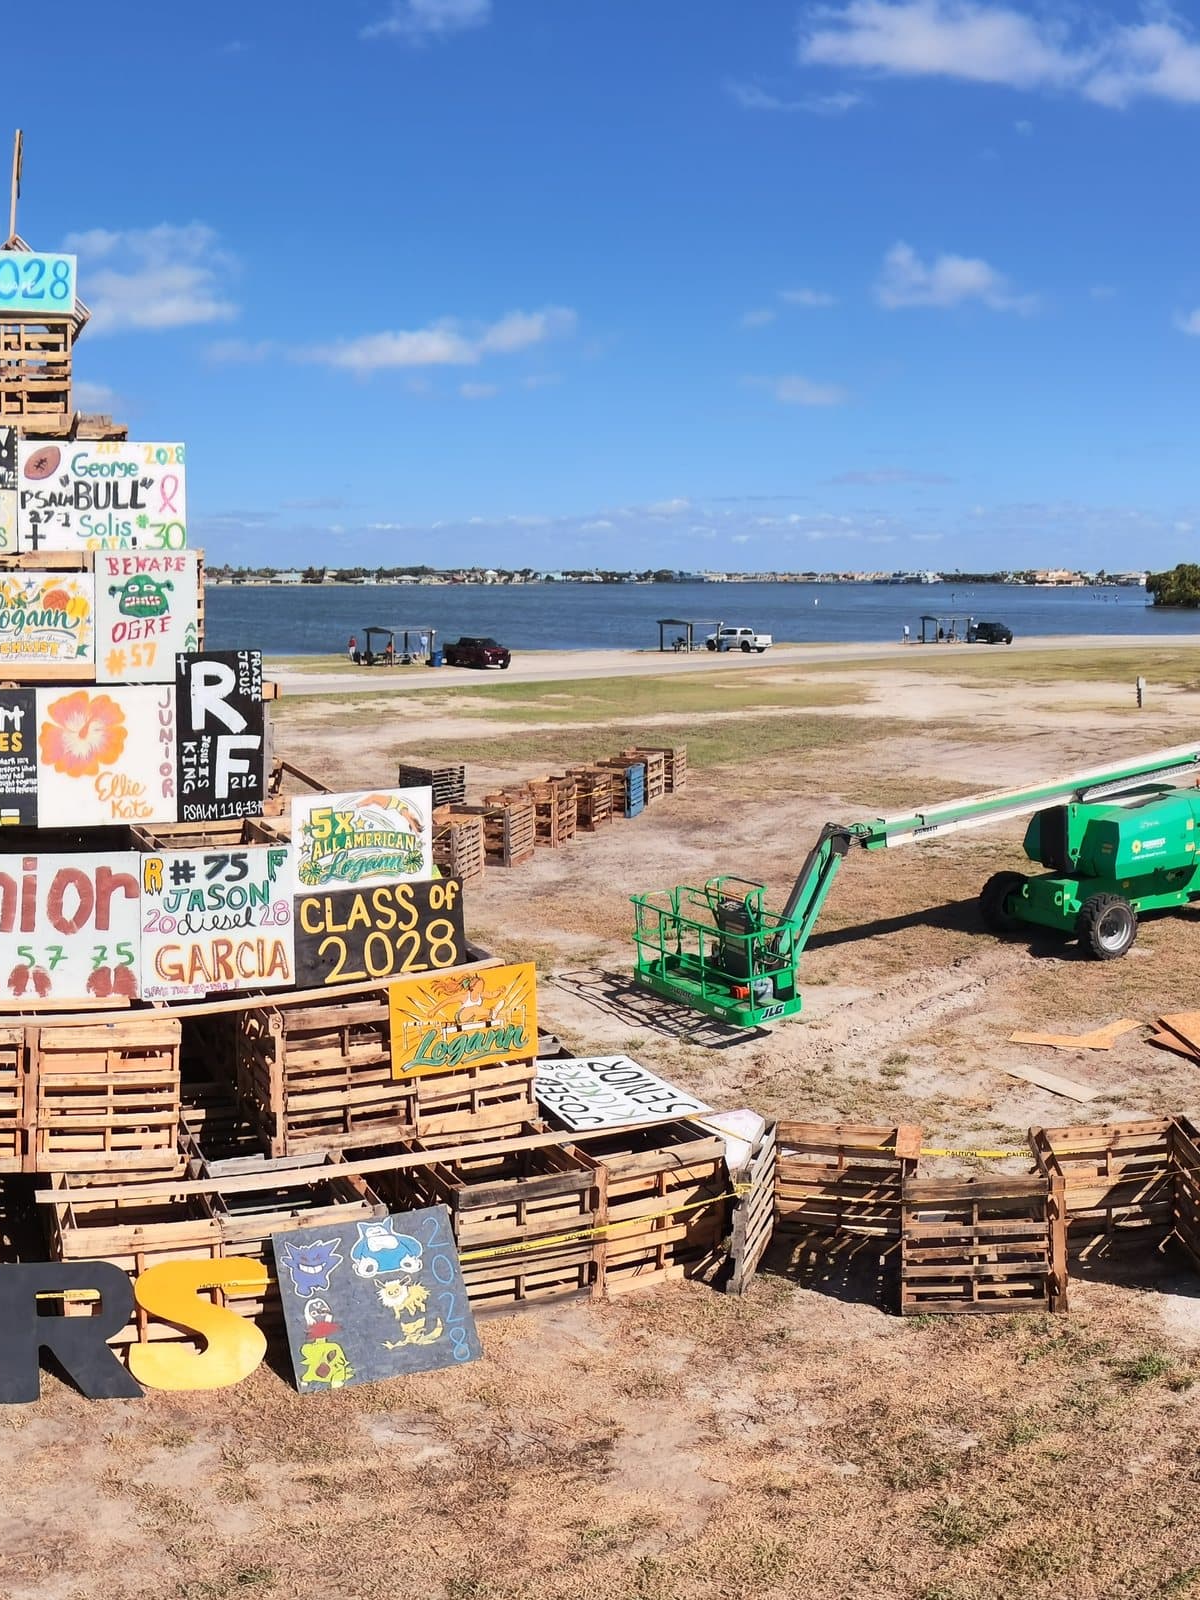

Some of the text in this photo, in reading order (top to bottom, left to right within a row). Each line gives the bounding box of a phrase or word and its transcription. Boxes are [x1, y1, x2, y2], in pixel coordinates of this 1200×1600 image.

[144, 444, 185, 465] 2028
[76, 512, 132, 537] Solis
[105, 556, 186, 576] BEWARE
[111, 615, 172, 643] OGRE
[182, 741, 197, 795] KING
[230, 775, 258, 789] 212
[310, 831, 417, 862] ALL AMERICAN
[163, 880, 270, 913] JASON
[259, 899, 291, 926] 28
[300, 883, 419, 934] CLASS
[155, 936, 290, 985] GARCIA
[318, 918, 458, 985] 2028
[761, 1004, 785, 1019] JLG
[401, 1024, 529, 1073] Logann
[555, 1071, 649, 1120] KICKER
[587, 1061, 699, 1114] SENIOR
